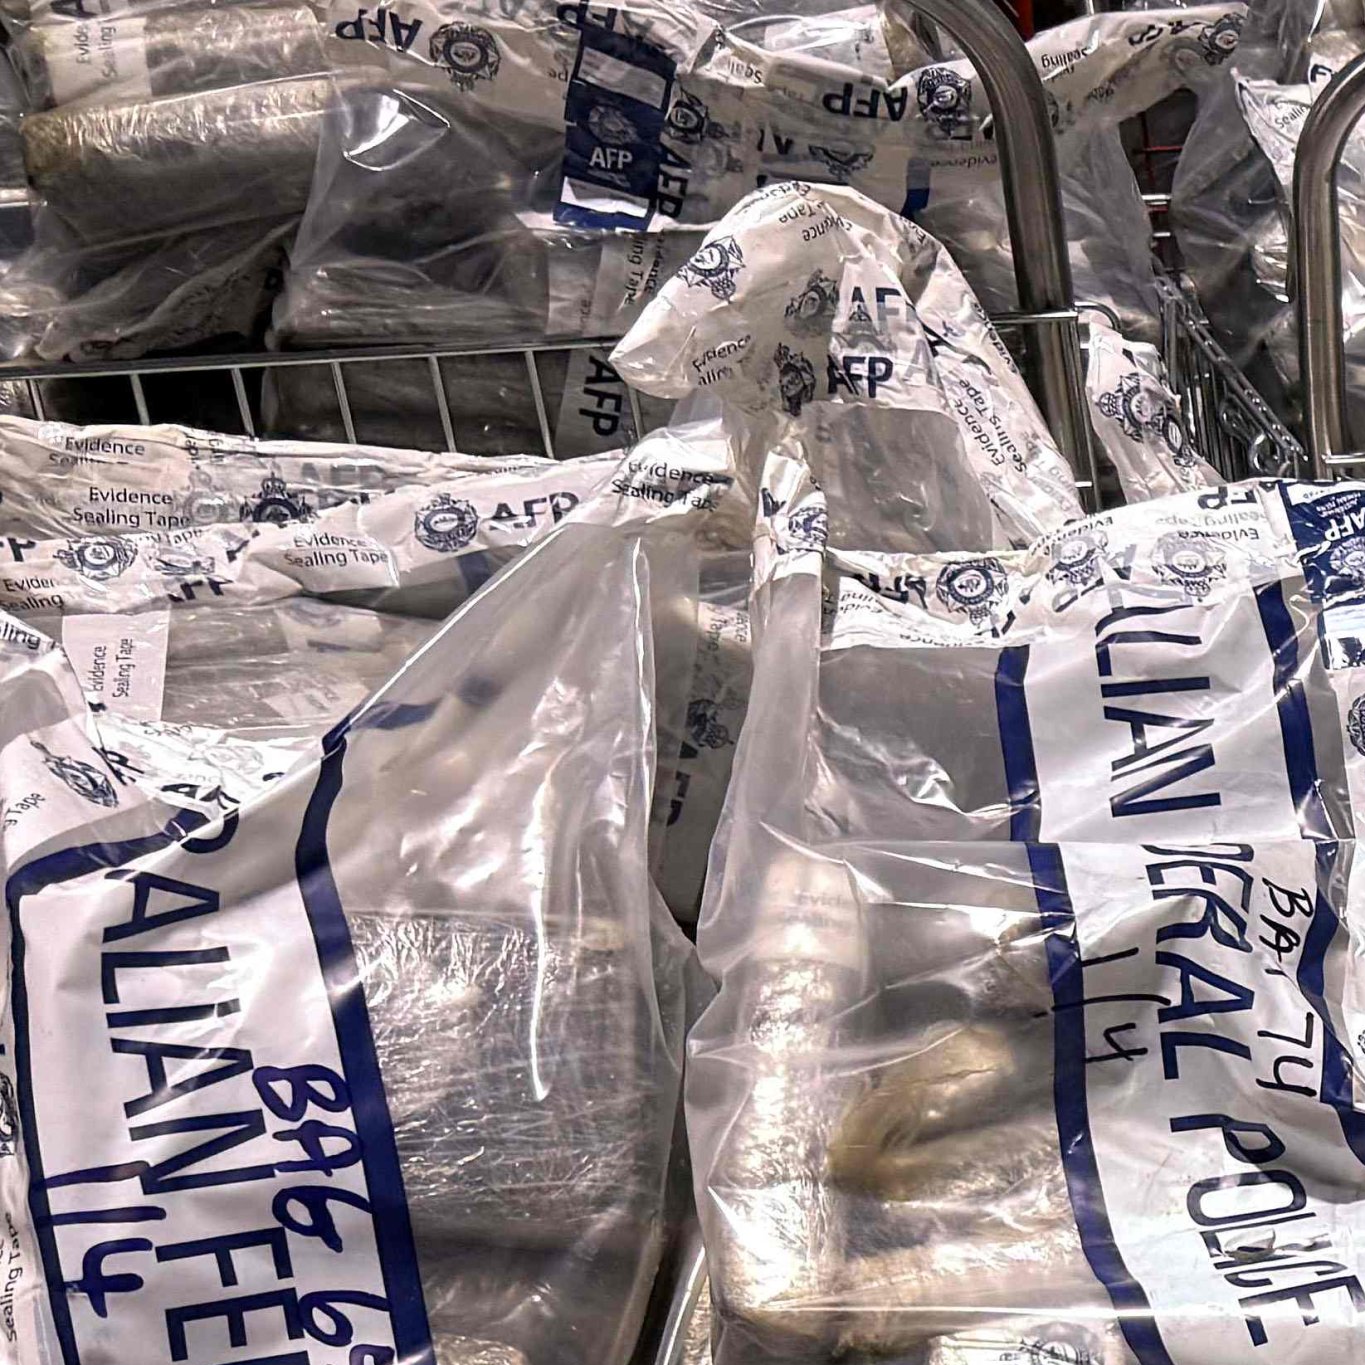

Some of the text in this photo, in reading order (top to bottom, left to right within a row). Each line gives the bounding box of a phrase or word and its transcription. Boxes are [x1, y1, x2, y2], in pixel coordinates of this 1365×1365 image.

[822, 82, 907, 122] AFP
[589, 147, 632, 169] AFP
[578, 355, 622, 437] AFP
[826, 355, 893, 399] AFP
[65, 436, 145, 457] Evidence
[88, 487, 173, 505] Evidence
[489, 491, 580, 530] AFP
[72, 507, 190, 529] Sealing Tape
[347, 548, 390, 567] Tape
[1094, 604, 1222, 818] LIAN
[1255, 1011, 1318, 1097] 74
